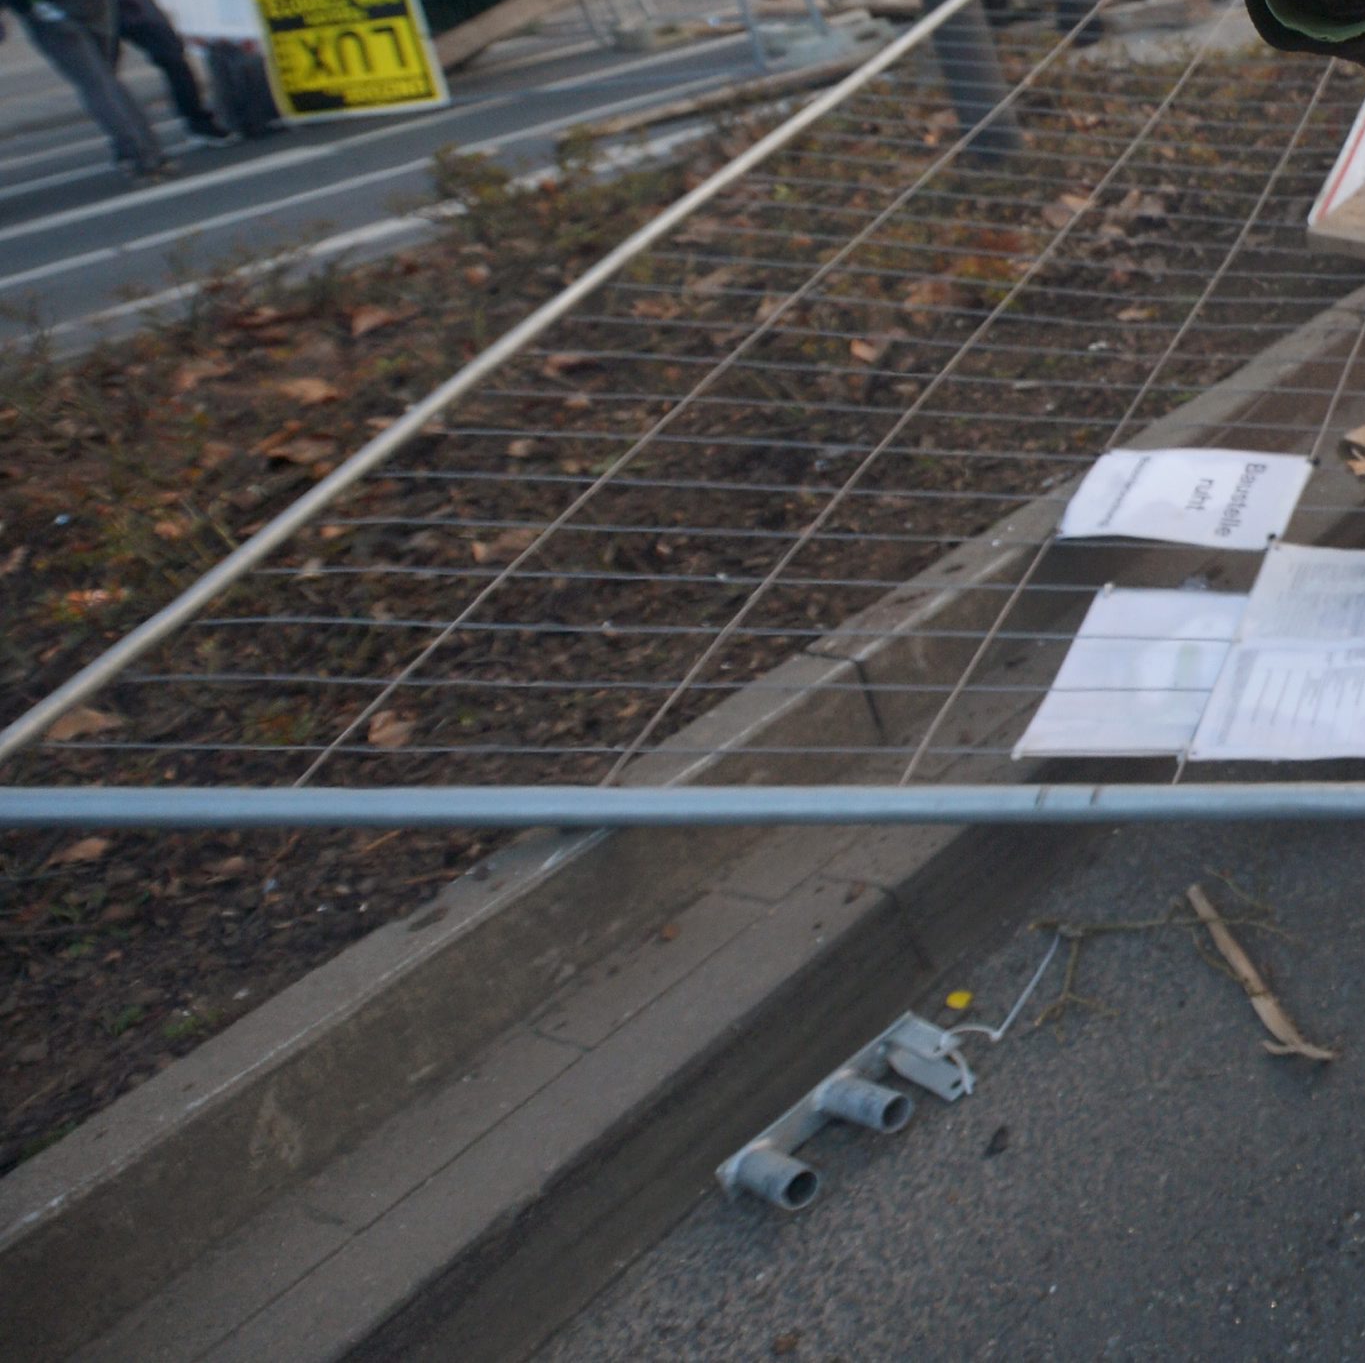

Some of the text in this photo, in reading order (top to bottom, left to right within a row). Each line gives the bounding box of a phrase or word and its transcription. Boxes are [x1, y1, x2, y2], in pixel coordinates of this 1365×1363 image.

[305, 22, 408, 73] LUX
[1181, 476, 1216, 514] ruht
[1213, 462, 1268, 538] Baustelle
